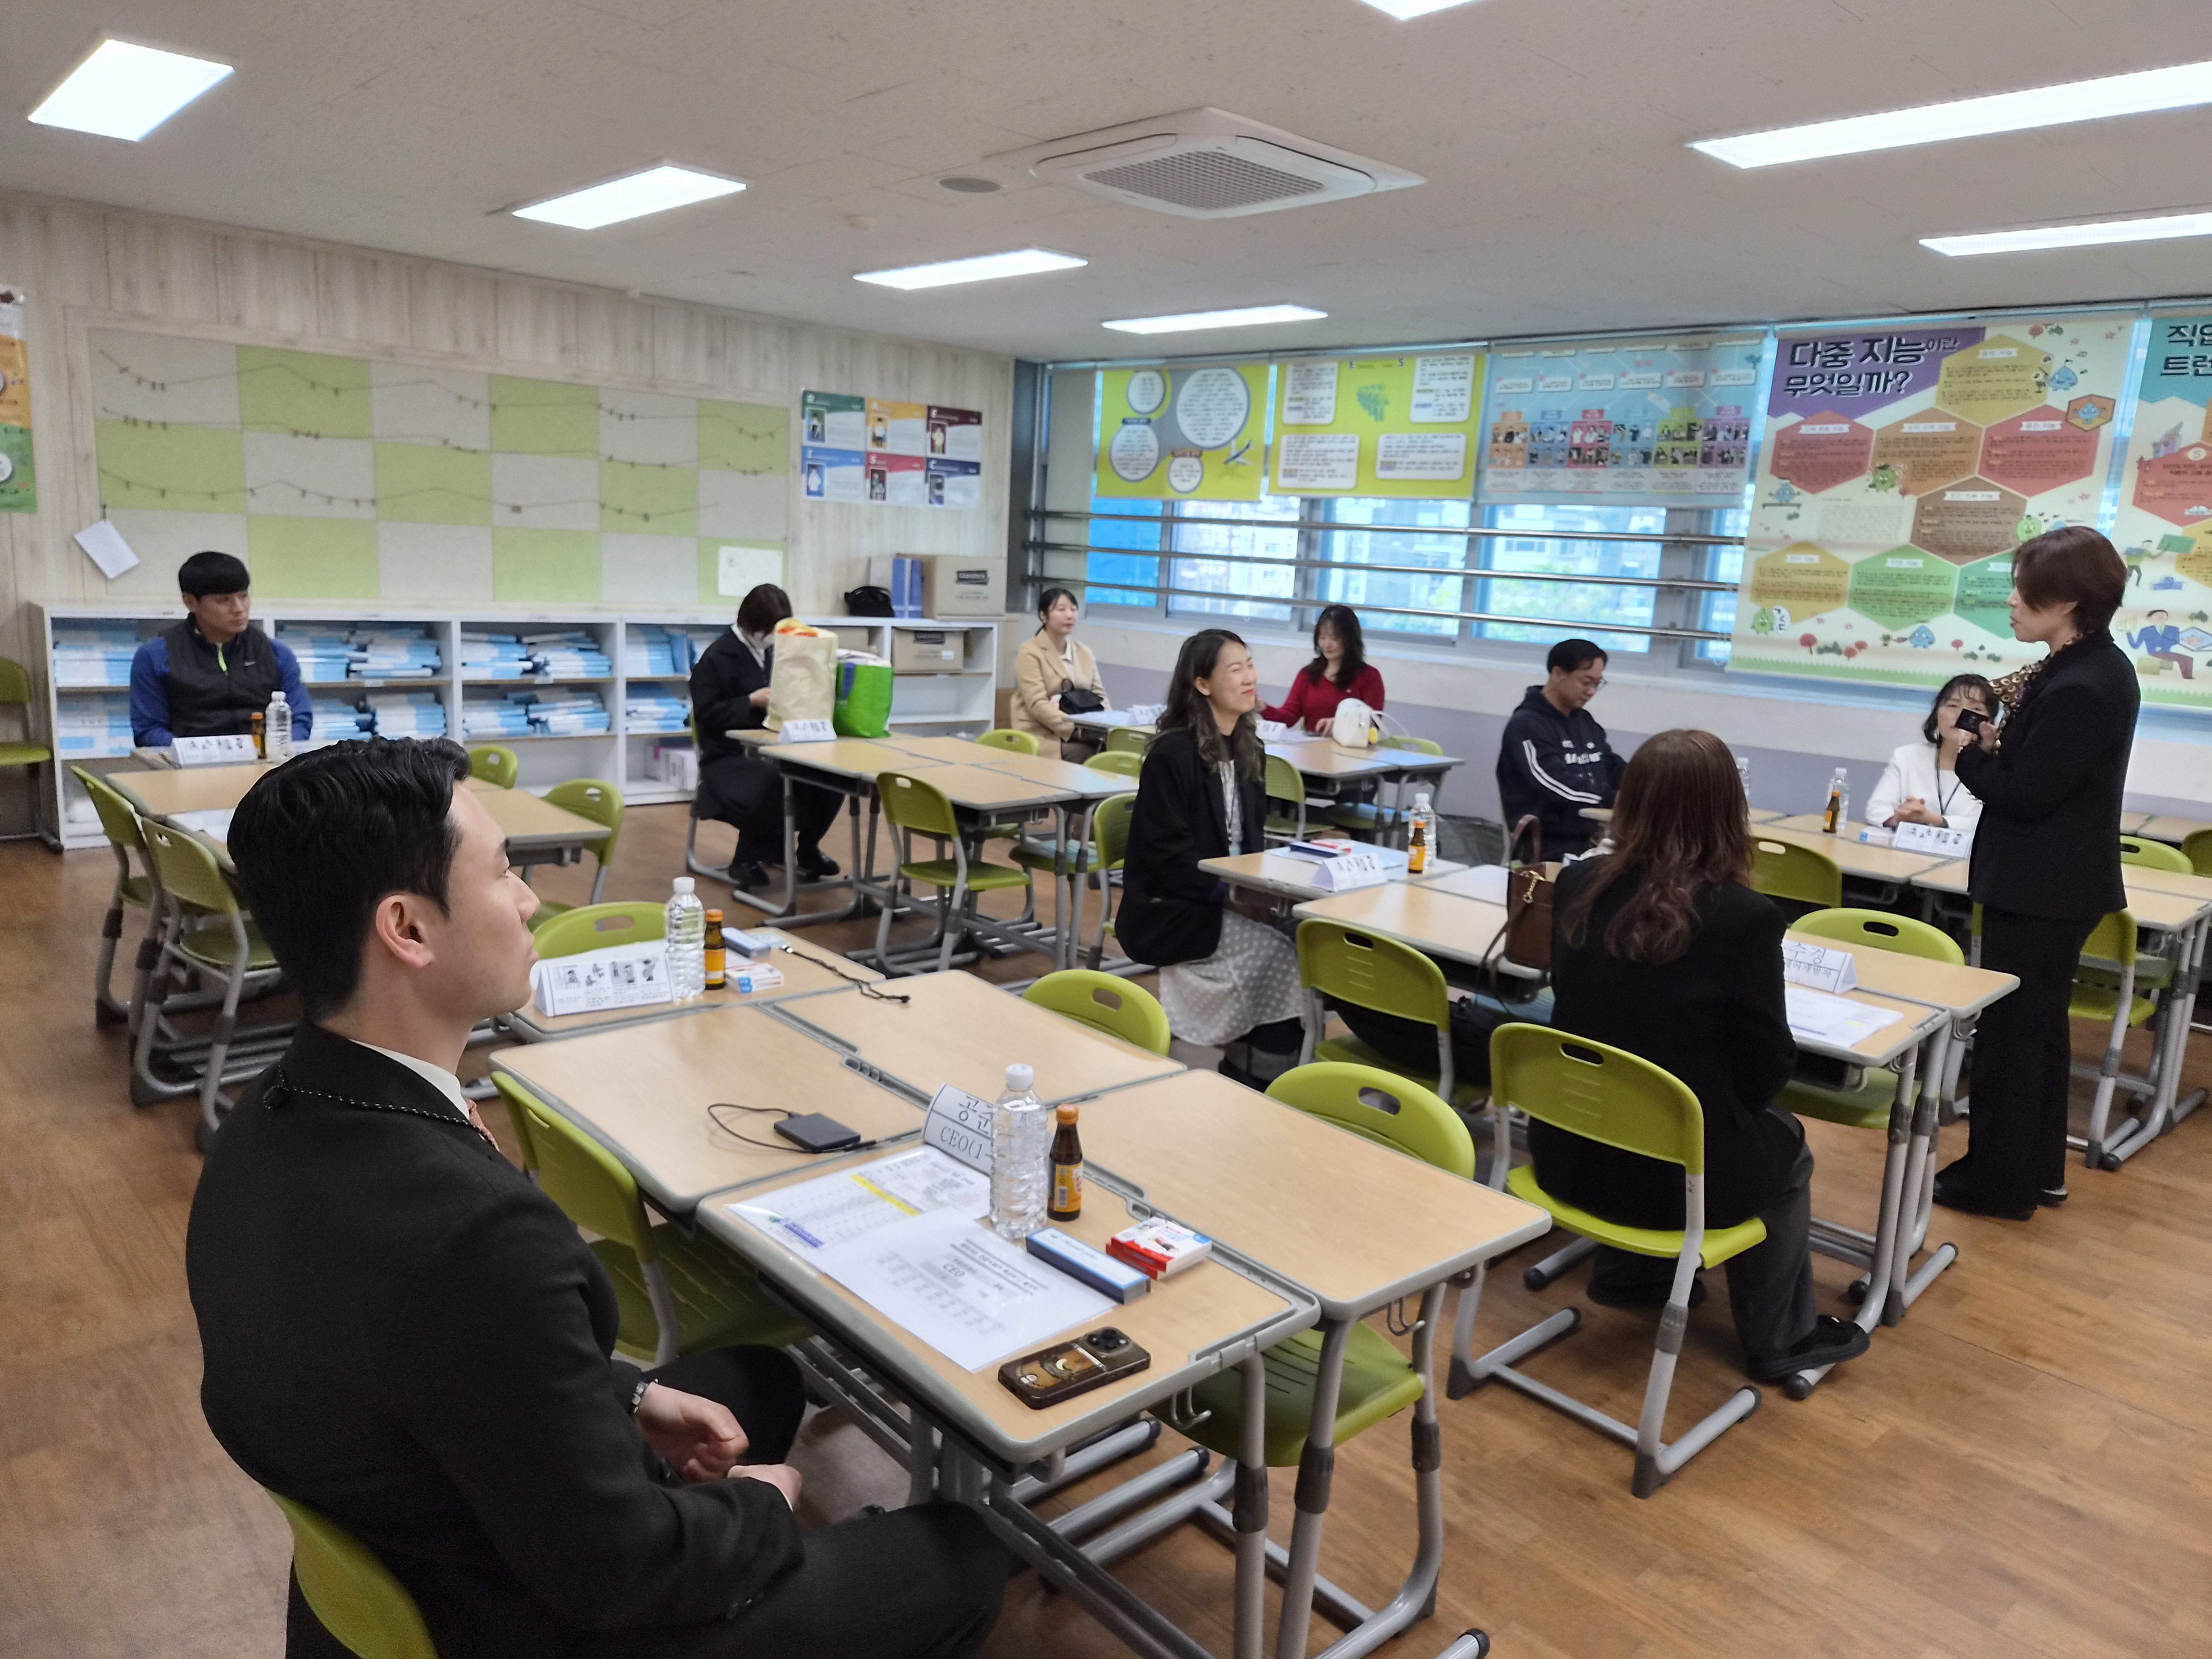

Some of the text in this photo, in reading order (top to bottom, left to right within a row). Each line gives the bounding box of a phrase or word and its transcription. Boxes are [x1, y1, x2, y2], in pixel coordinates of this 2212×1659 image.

[1790, 336, 1960, 370] 다중 지능이란
[1784, 371, 1913, 398] 무엇일까?
[1784, 942, 1827, 964] 수경
[943, 1263, 965, 1277] CEO
